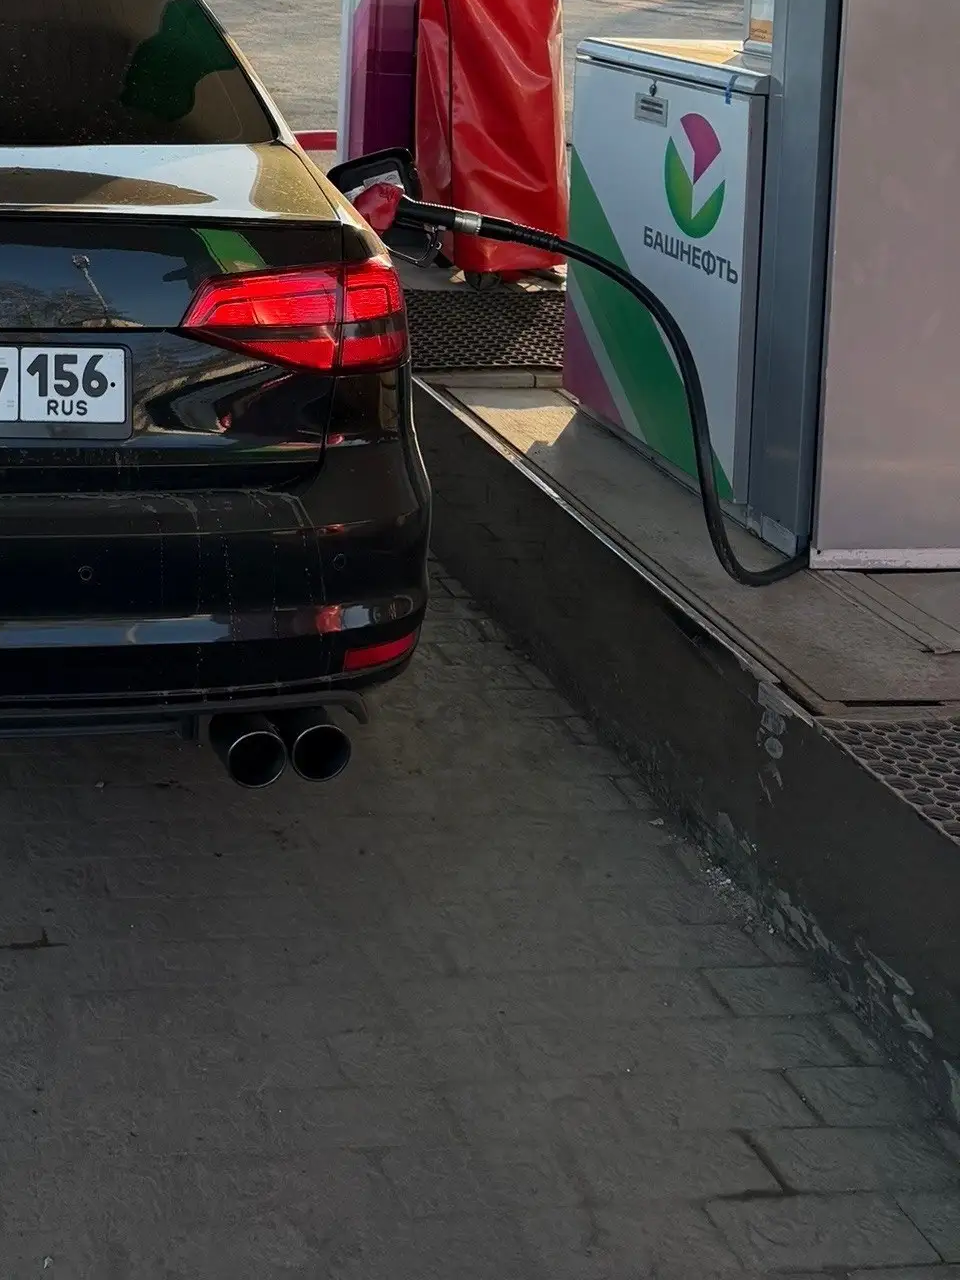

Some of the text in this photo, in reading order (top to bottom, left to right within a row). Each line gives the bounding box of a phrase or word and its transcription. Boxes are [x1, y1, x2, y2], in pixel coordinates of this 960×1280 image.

[643, 225, 739, 285] БАШНЕФТЬ
[26, 354, 108, 398] 156
[46, 399, 88, 416] RUS
